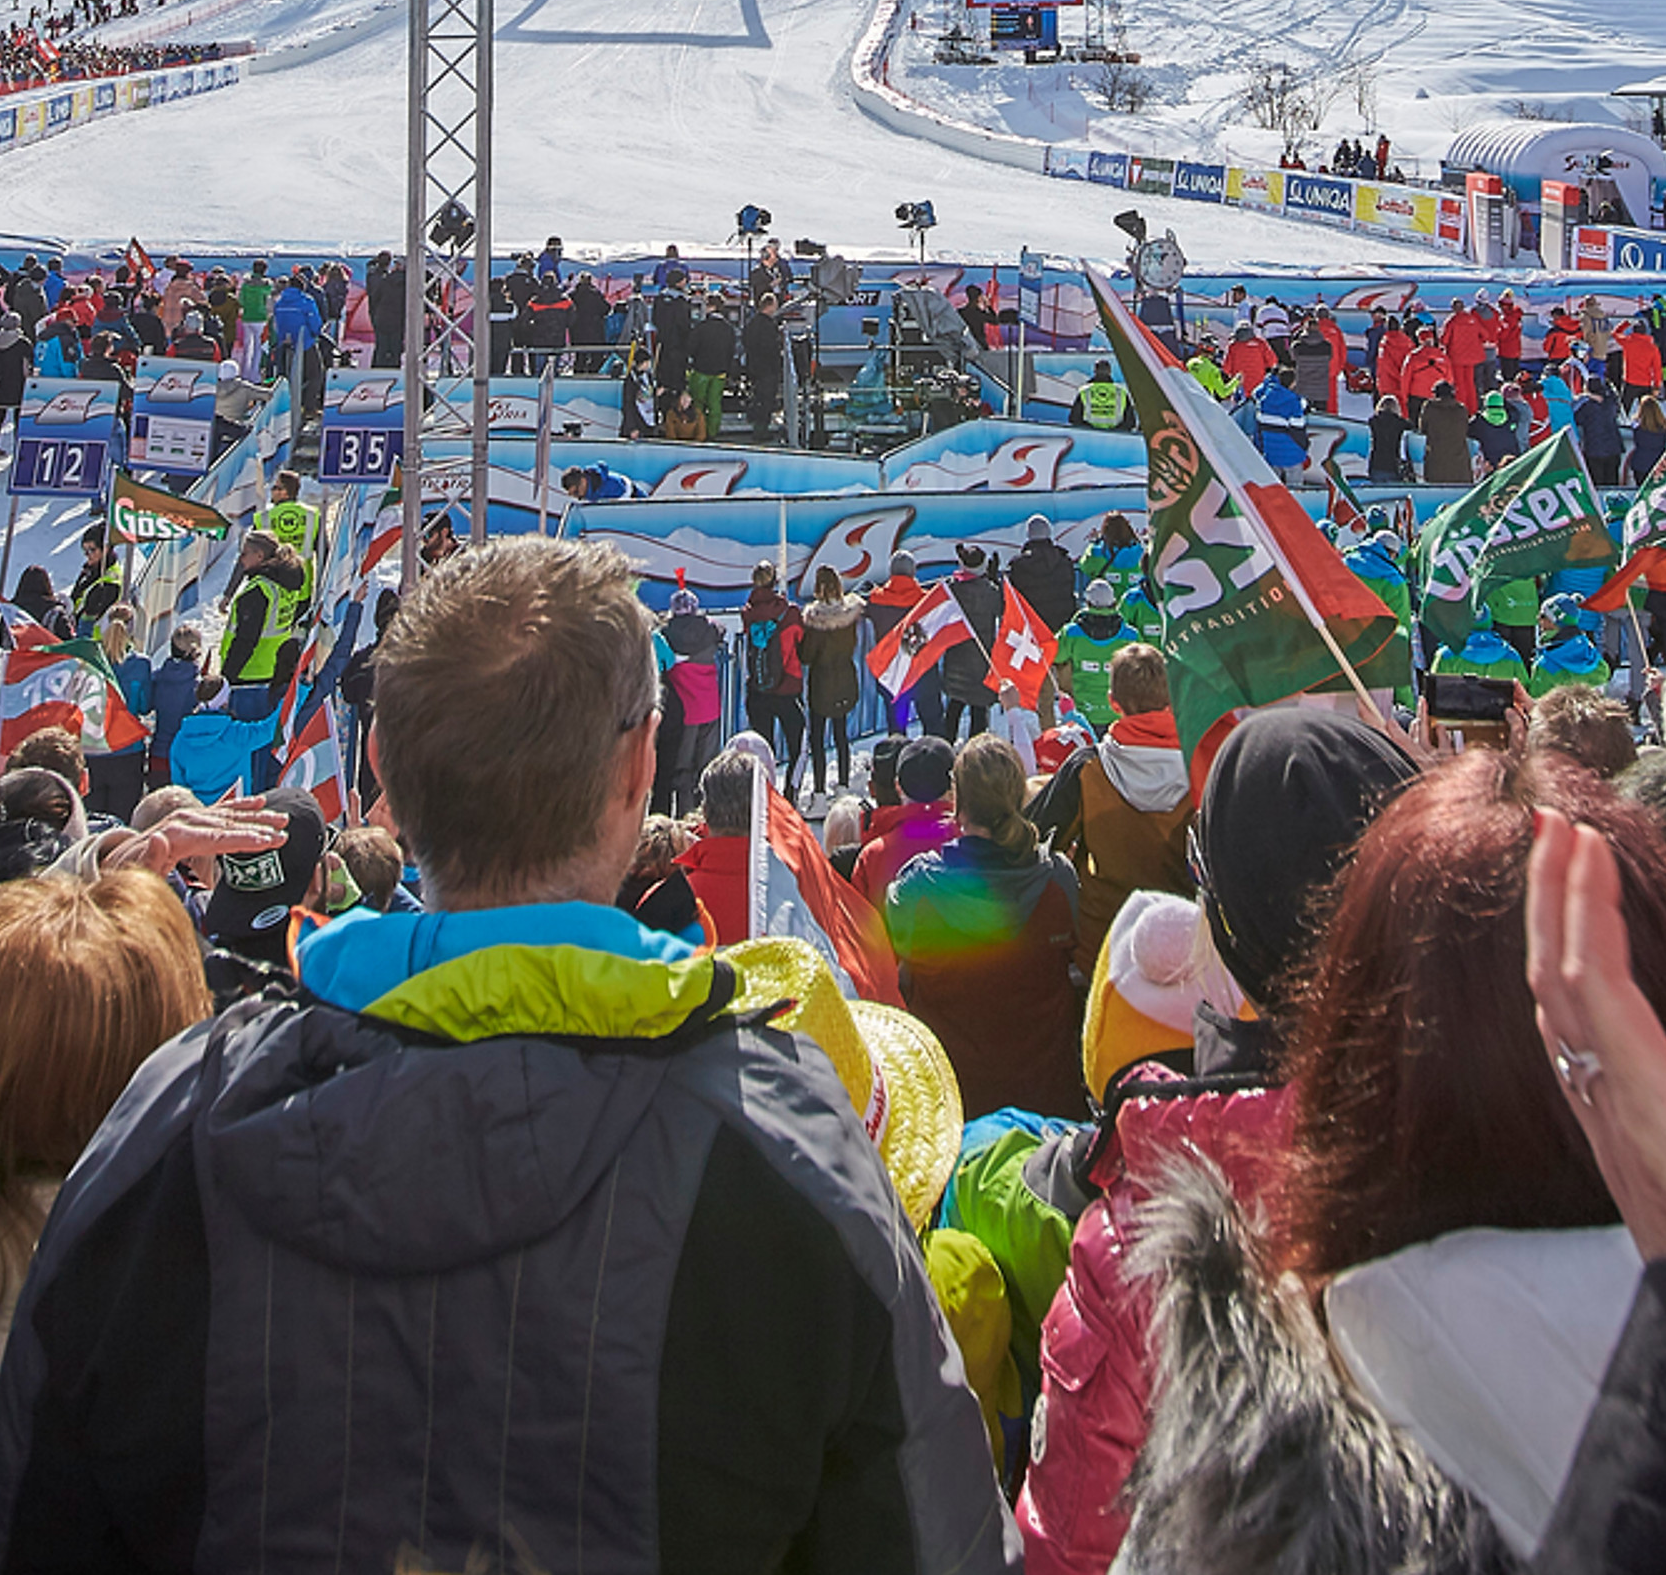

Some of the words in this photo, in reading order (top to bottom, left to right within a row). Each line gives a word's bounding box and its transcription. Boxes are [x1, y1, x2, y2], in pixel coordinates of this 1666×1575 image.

[1305, 185, 1351, 212] UNIQA
[43, 447, 82, 482] 12
[341, 435, 385, 471] 35
[1165, 581, 1290, 655] UTRADITIO
